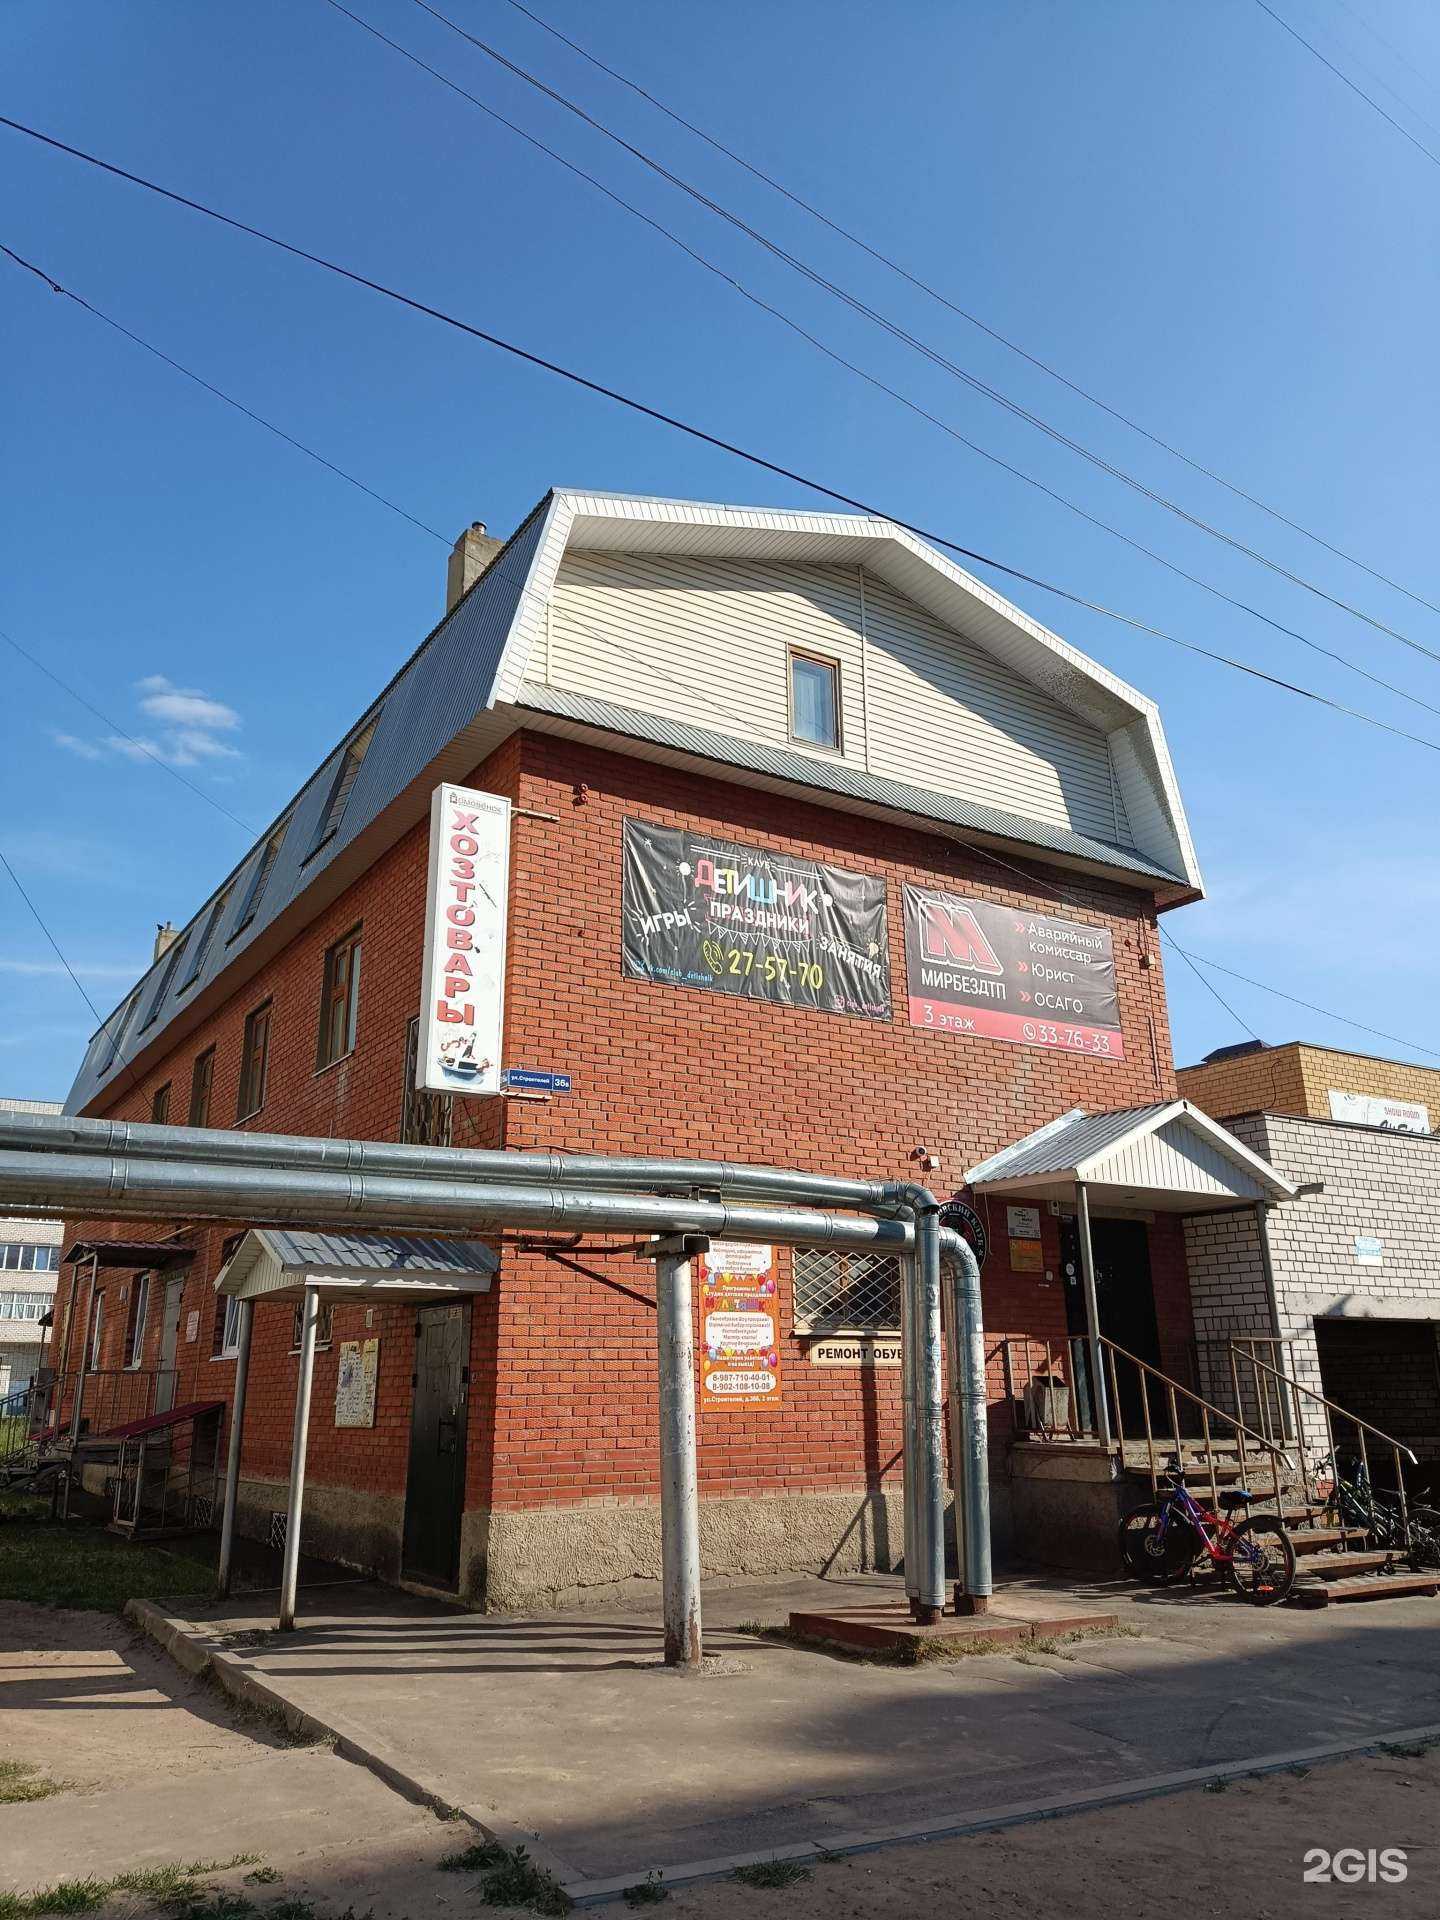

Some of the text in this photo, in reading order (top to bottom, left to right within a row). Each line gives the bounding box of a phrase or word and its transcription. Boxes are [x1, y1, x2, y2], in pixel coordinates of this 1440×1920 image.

[747, 857, 771, 869] КЛУБ
[694, 859, 819, 914] ДЕТИШНИК
[437, 809, 480, 1026] ХОЗТОВАРЫ
[639, 907, 692, 935] ИГРЫ
[709, 902, 809, 934] ПРАЗДНИКИ
[1027, 922, 1103, 950] Аварийный
[819, 934, 882, 979] ЗАНЯТИЯ
[1029, 941, 1092, 966] комиссар
[727, 949, 823, 990] 27-57-70
[1031, 963, 1076, 984] Юрист
[921, 968, 1007, 1000] МИРБЕЗДТП
[1034, 992, 1083, 1014] ОСАГО
[923, 1005, 975, 1030] 3 этаж
[1038, 1024, 1110, 1052] 33-76-33
[818, 1347, 868, 1360] РЕМОНТ
